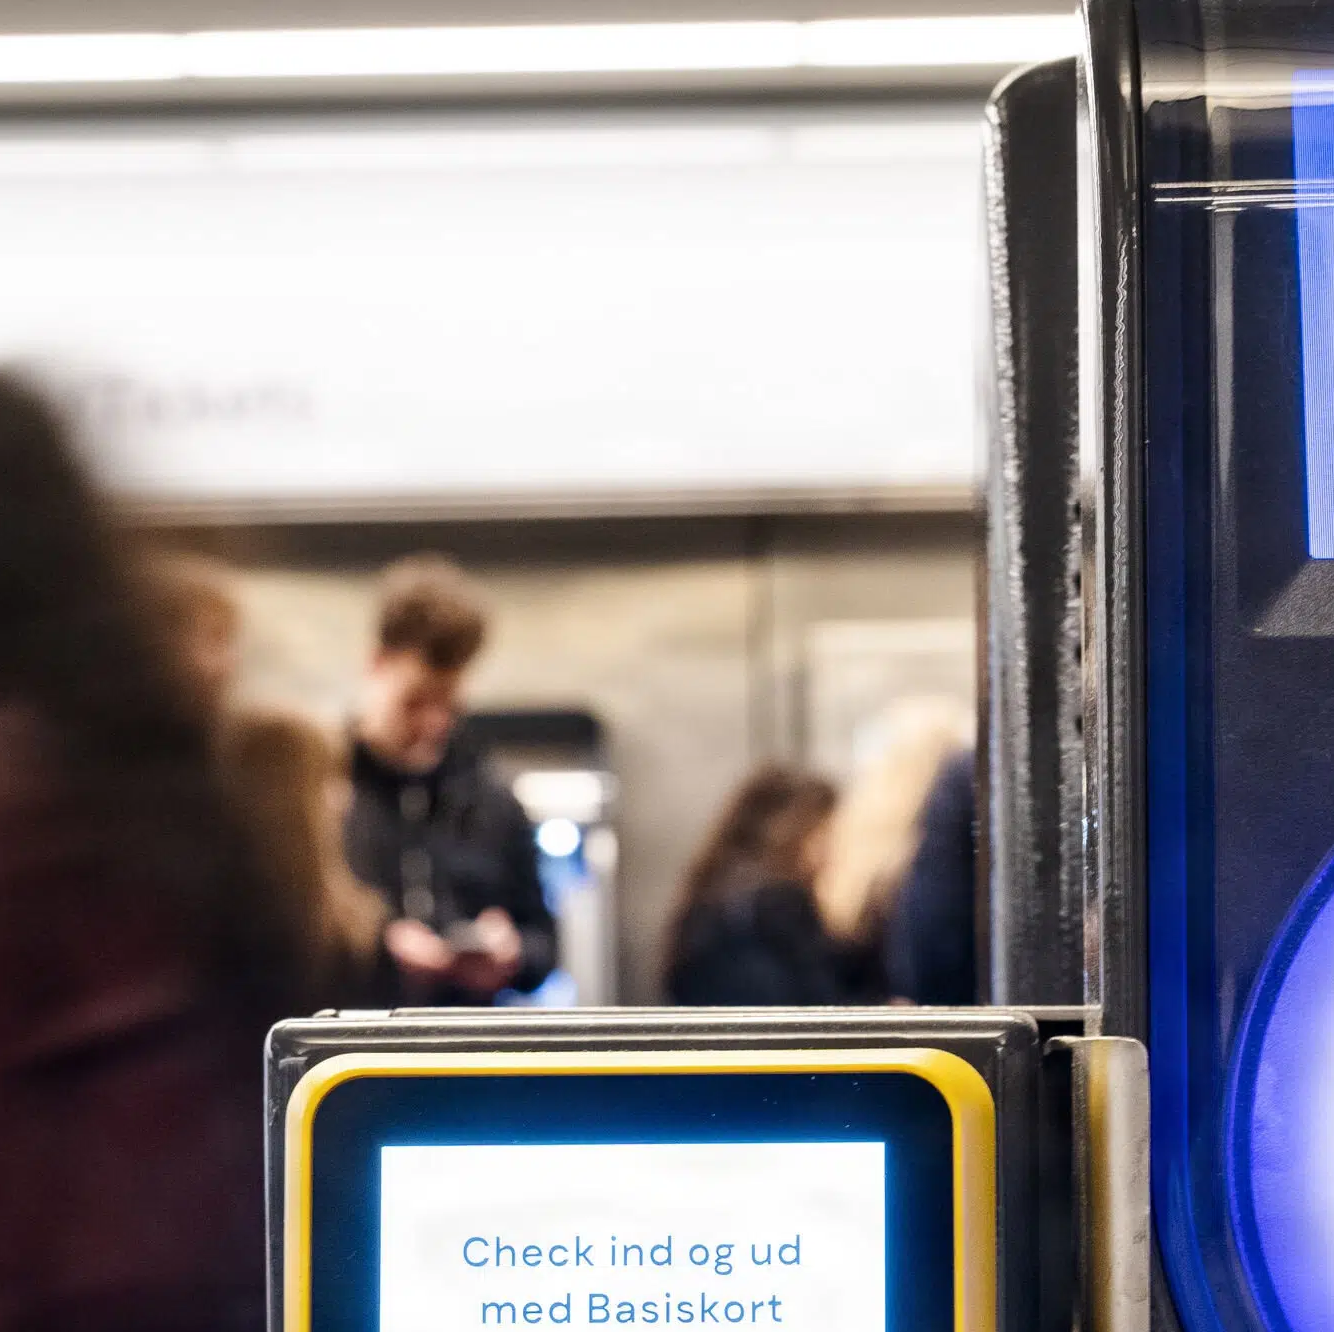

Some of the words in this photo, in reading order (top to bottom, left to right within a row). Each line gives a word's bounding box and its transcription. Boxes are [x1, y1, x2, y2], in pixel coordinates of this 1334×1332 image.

[462, 1236, 594, 1268] Check
[611, 1235, 672, 1267] ind
[688, 1243, 735, 1276] og
[750, 1235, 801, 1266] ud
[481, 1293, 572, 1324] med
[588, 1292, 783, 1324] Basiskort
